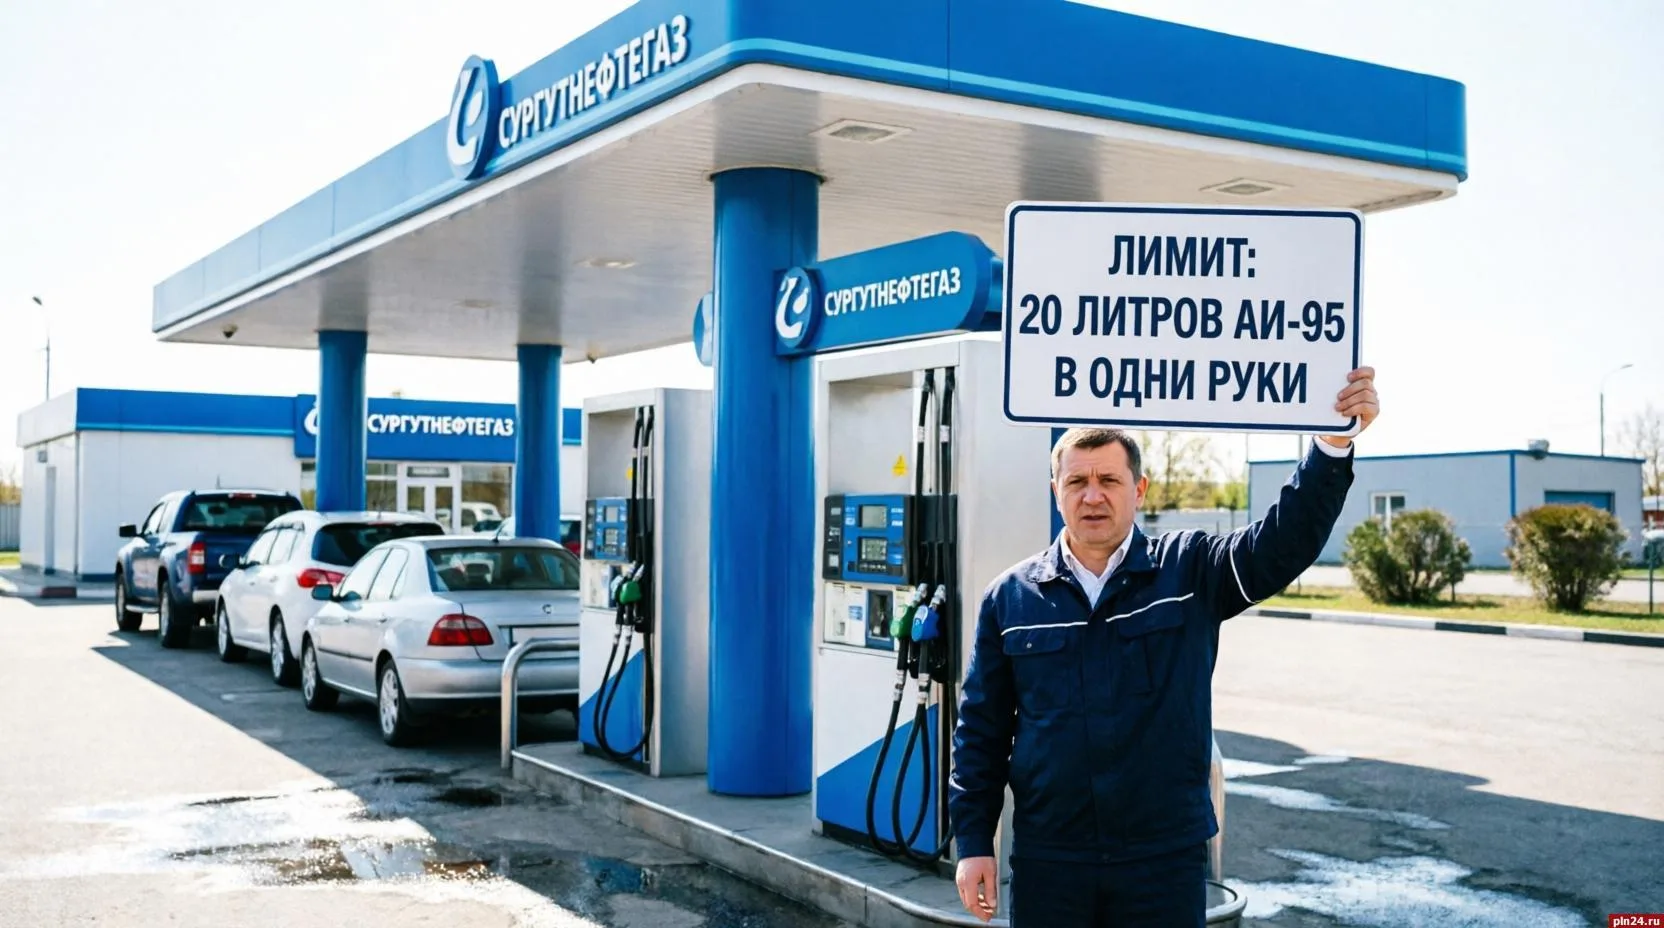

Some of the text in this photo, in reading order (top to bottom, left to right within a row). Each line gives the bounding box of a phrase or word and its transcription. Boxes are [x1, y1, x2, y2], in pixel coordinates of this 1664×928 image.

[499, 14, 688, 149] СУРГУТНЕФТЕГАЗ
[1108, 234, 1256, 278] ЛИМИТ:
[824, 266, 961, 317] СУРГУТНЕФТЕГАЗ
[1019, 293, 1346, 343] 20 ЛИТРОВ АИ-95
[1054, 356, 1308, 408] В ОДНИ РУКИ
[367, 413, 515, 437] СУРГУТНЕФТЕГАЗ
